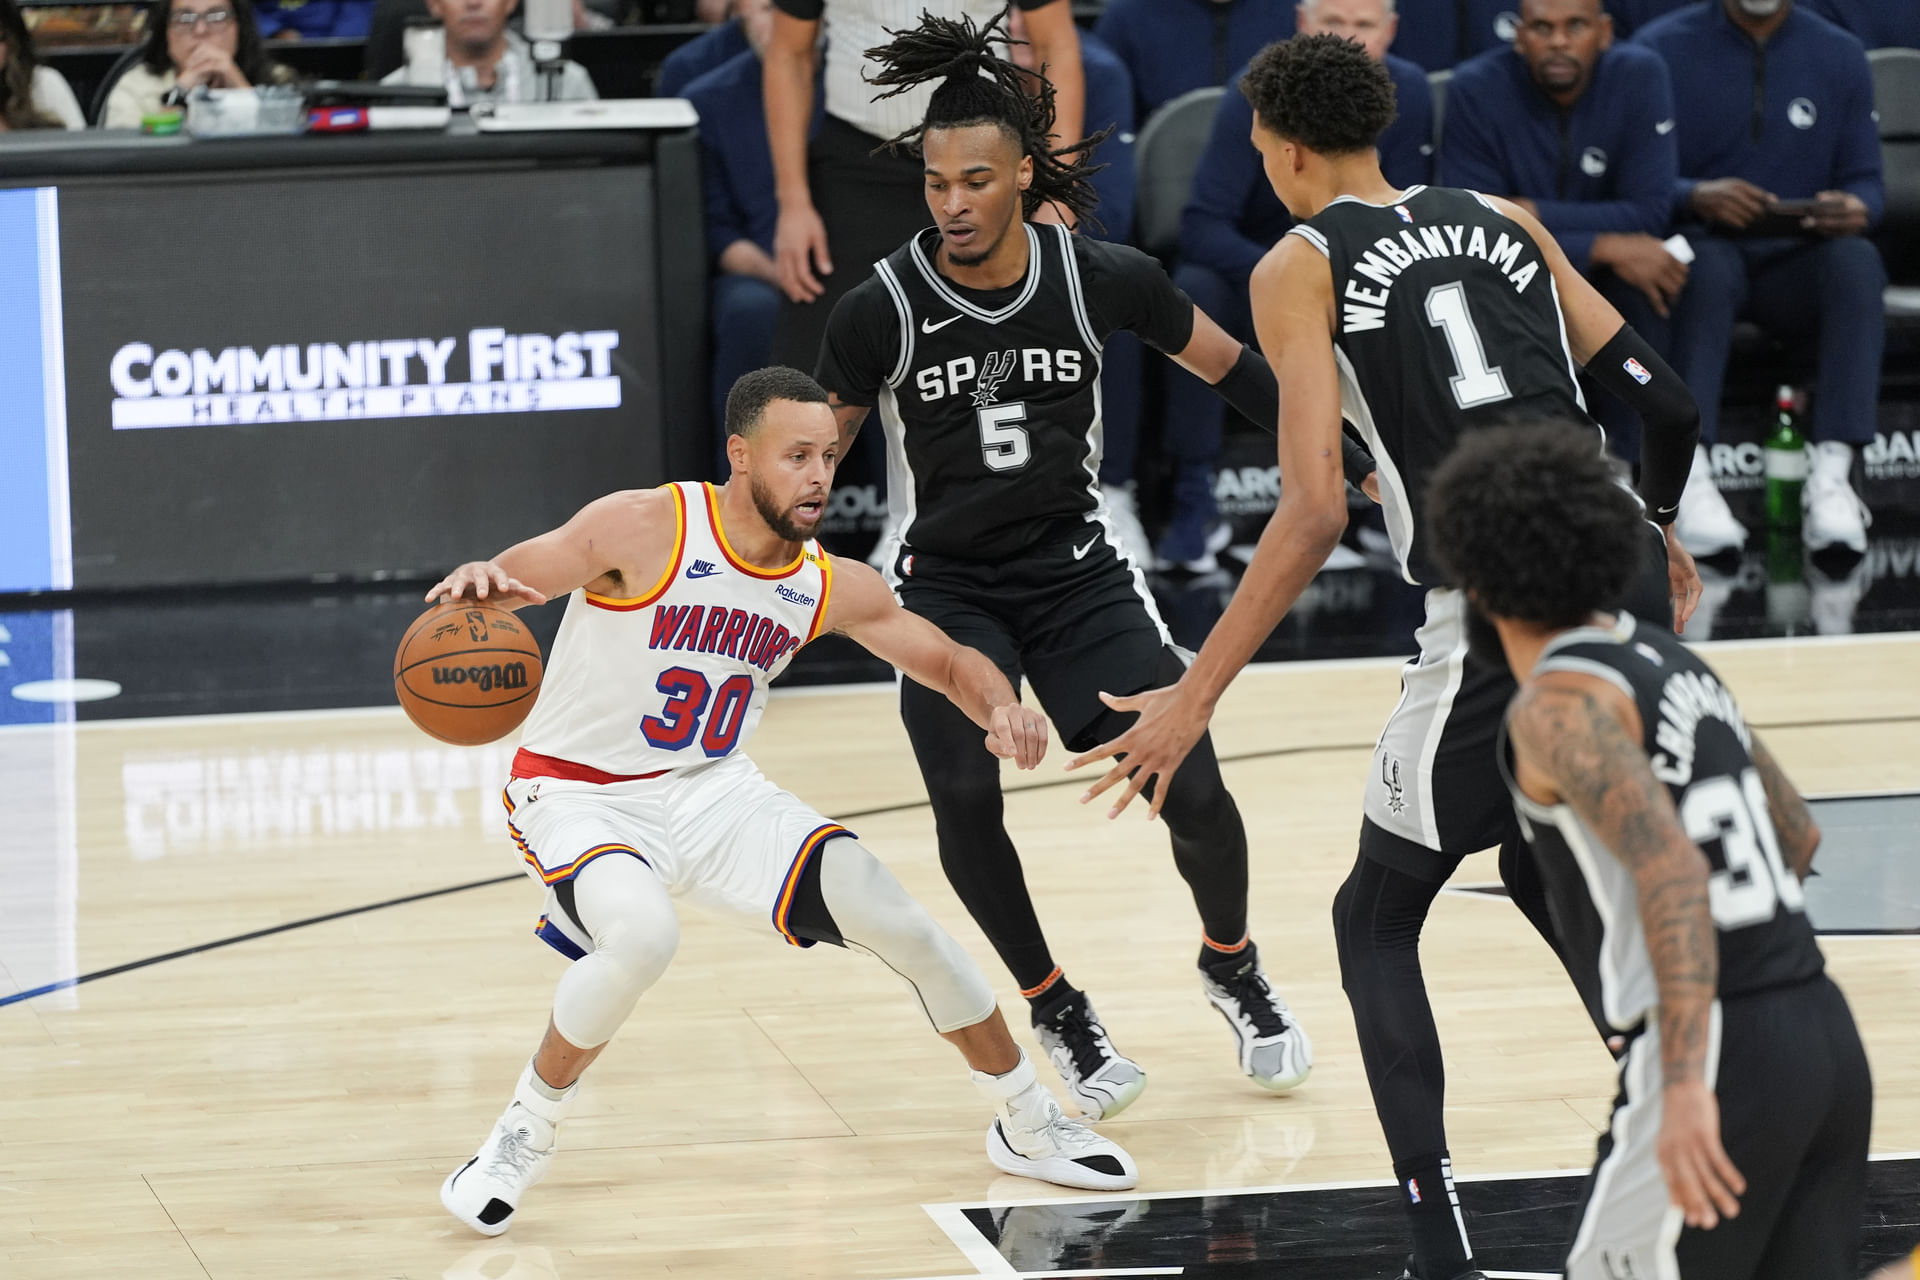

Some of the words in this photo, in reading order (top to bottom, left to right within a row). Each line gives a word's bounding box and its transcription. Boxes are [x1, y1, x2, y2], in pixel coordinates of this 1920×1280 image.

[1343, 225, 1539, 333] WEMBANYAMA
[110, 341, 457, 399] COMMUNITY
[469, 326, 620, 384] FIRST
[916, 349, 1082, 406] SPURS
[1424, 280, 1513, 410] 1
[976, 401, 1031, 472] 5
[692, 559, 716, 573] NIKE
[775, 583, 815, 607] Rakuten
[432, 661, 527, 692] Wilson
[640, 666, 754, 758] 30
